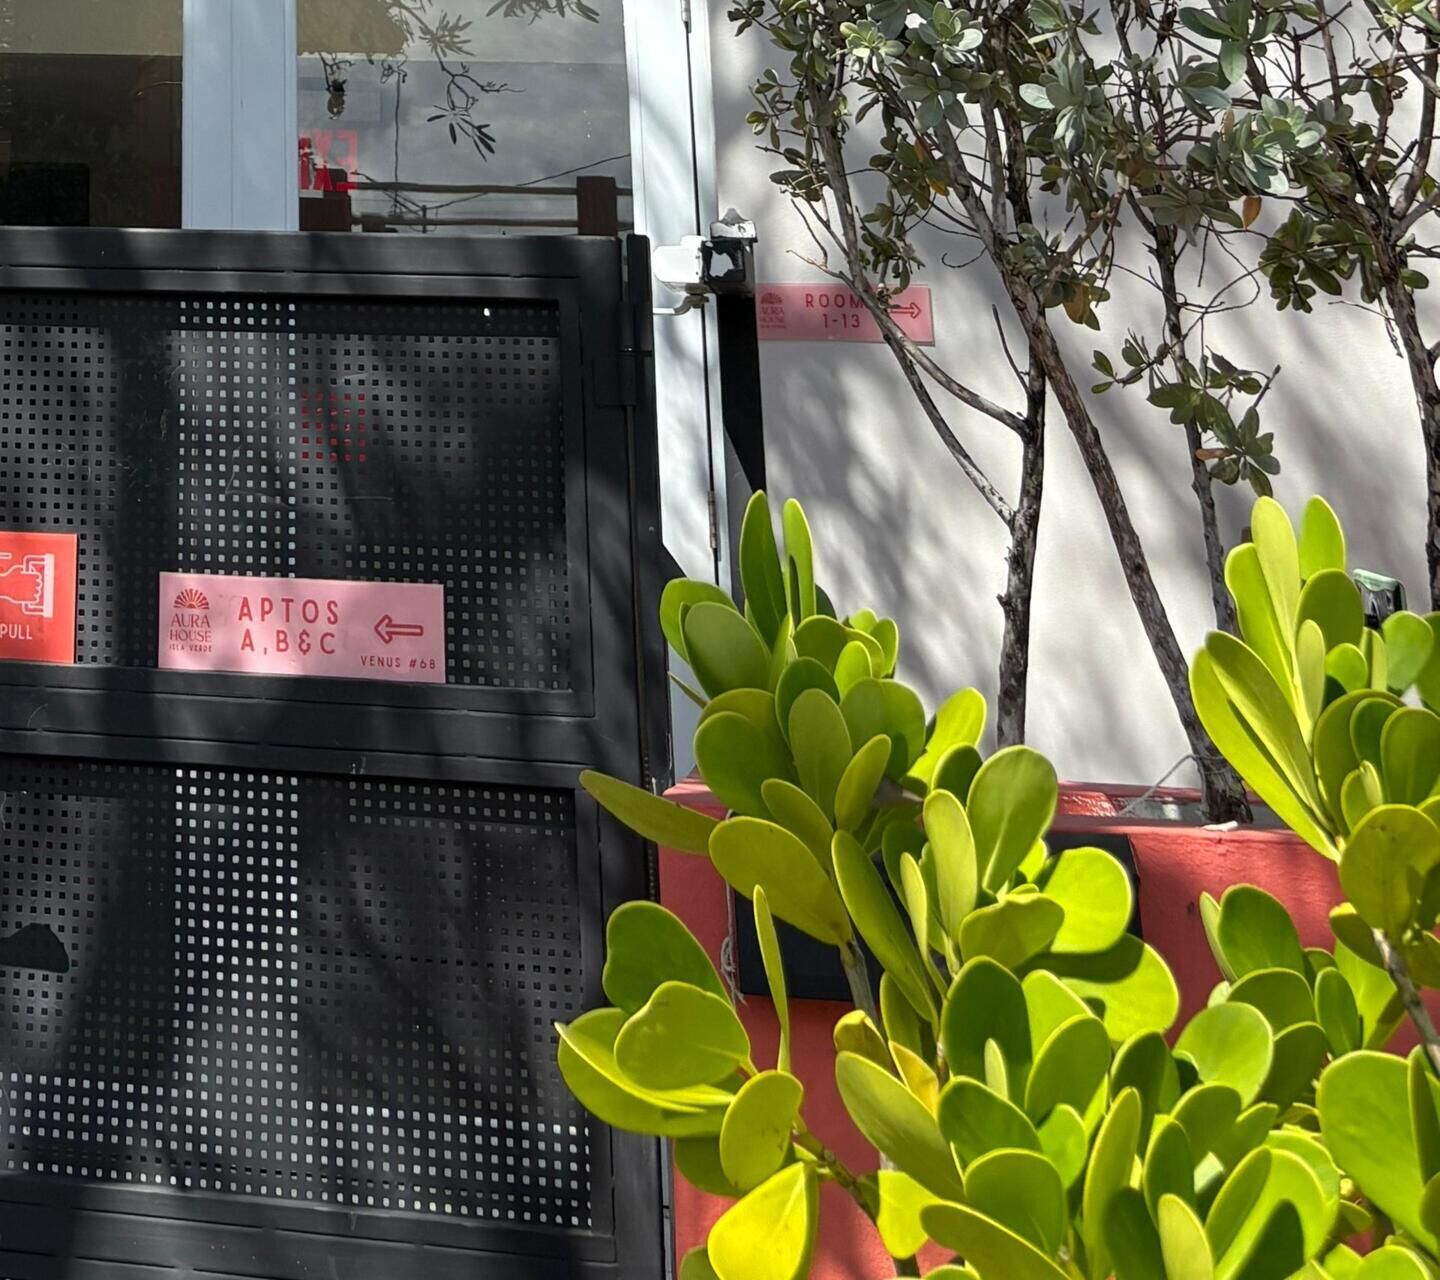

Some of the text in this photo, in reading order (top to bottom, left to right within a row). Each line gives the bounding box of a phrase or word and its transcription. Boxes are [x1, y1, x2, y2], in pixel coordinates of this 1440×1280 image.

[823, 313, 860, 329] 1-13
[238, 597, 339, 625] APTOS
[171, 613, 211, 629] AURA
[0, 623, 33, 640] PULL
[169, 629, 212, 642] HOUSE
[360, 655, 436, 670] VENUS #68
